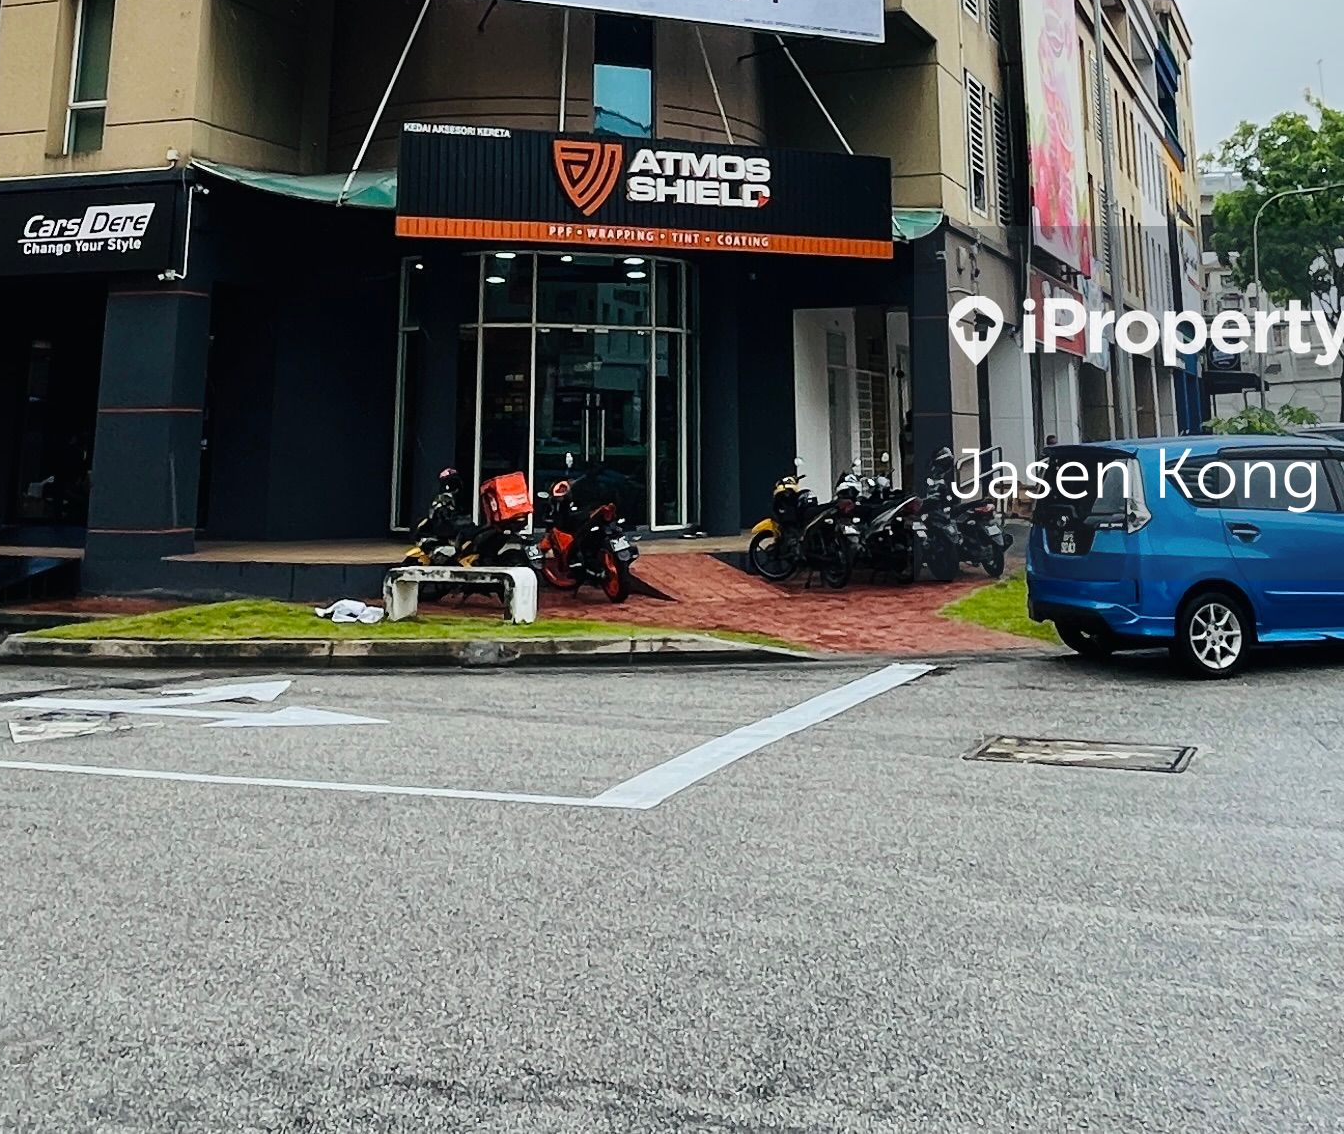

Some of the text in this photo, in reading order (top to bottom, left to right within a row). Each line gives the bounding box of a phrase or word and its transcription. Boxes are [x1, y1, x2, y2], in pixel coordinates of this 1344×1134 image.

[403, 122, 512, 139] KEDAI AKSESORI KERETA
[627, 148, 771, 183] ATMOS
[626, 176, 771, 208] SHIELD
[22, 215, 82, 239] Cars
[548, 226, 769, 248] PPF WRAPPING TINT COATING
[22, 237, 142, 257] Change Your Style
